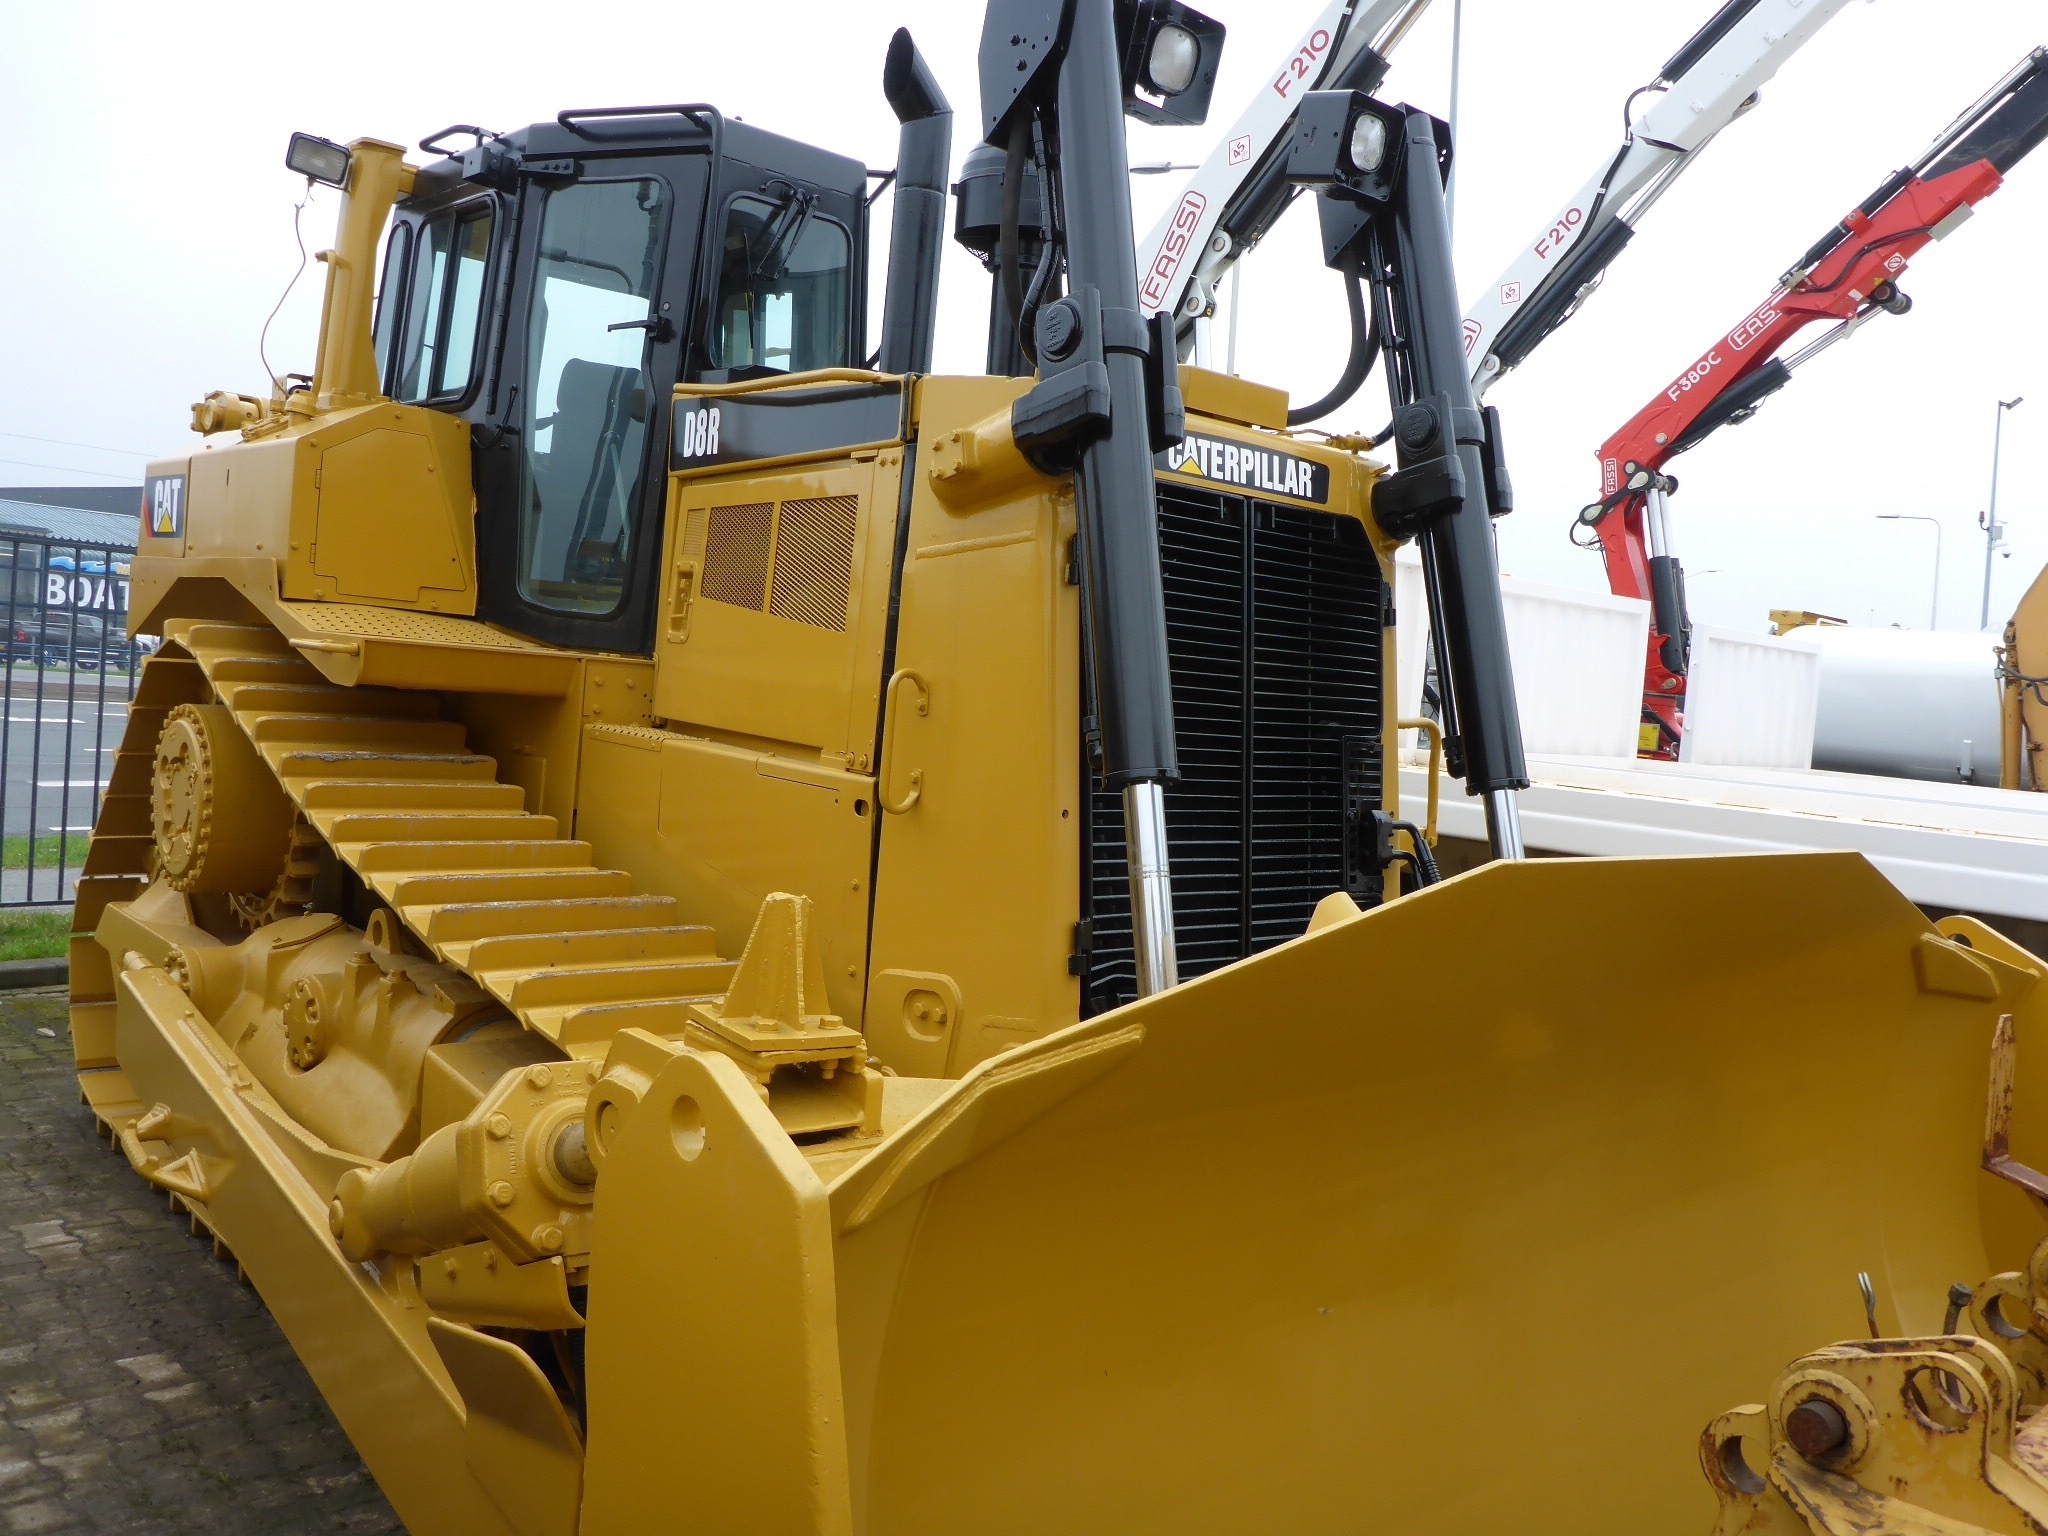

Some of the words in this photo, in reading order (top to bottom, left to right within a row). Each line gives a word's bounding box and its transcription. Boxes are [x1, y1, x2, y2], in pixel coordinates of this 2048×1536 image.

[1232, 142, 1246, 158] 45
[1144, 199, 1202, 301] FASSI
[1504, 286, 1517, 300] 45
[1667, 351, 1722, 402] F380C
[683, 408, 720, 457] D8R
[1168, 436, 1312, 498] CATERPILLAR
[1606, 461, 1616, 492] FASSI
[153, 478, 183, 532] CAT
